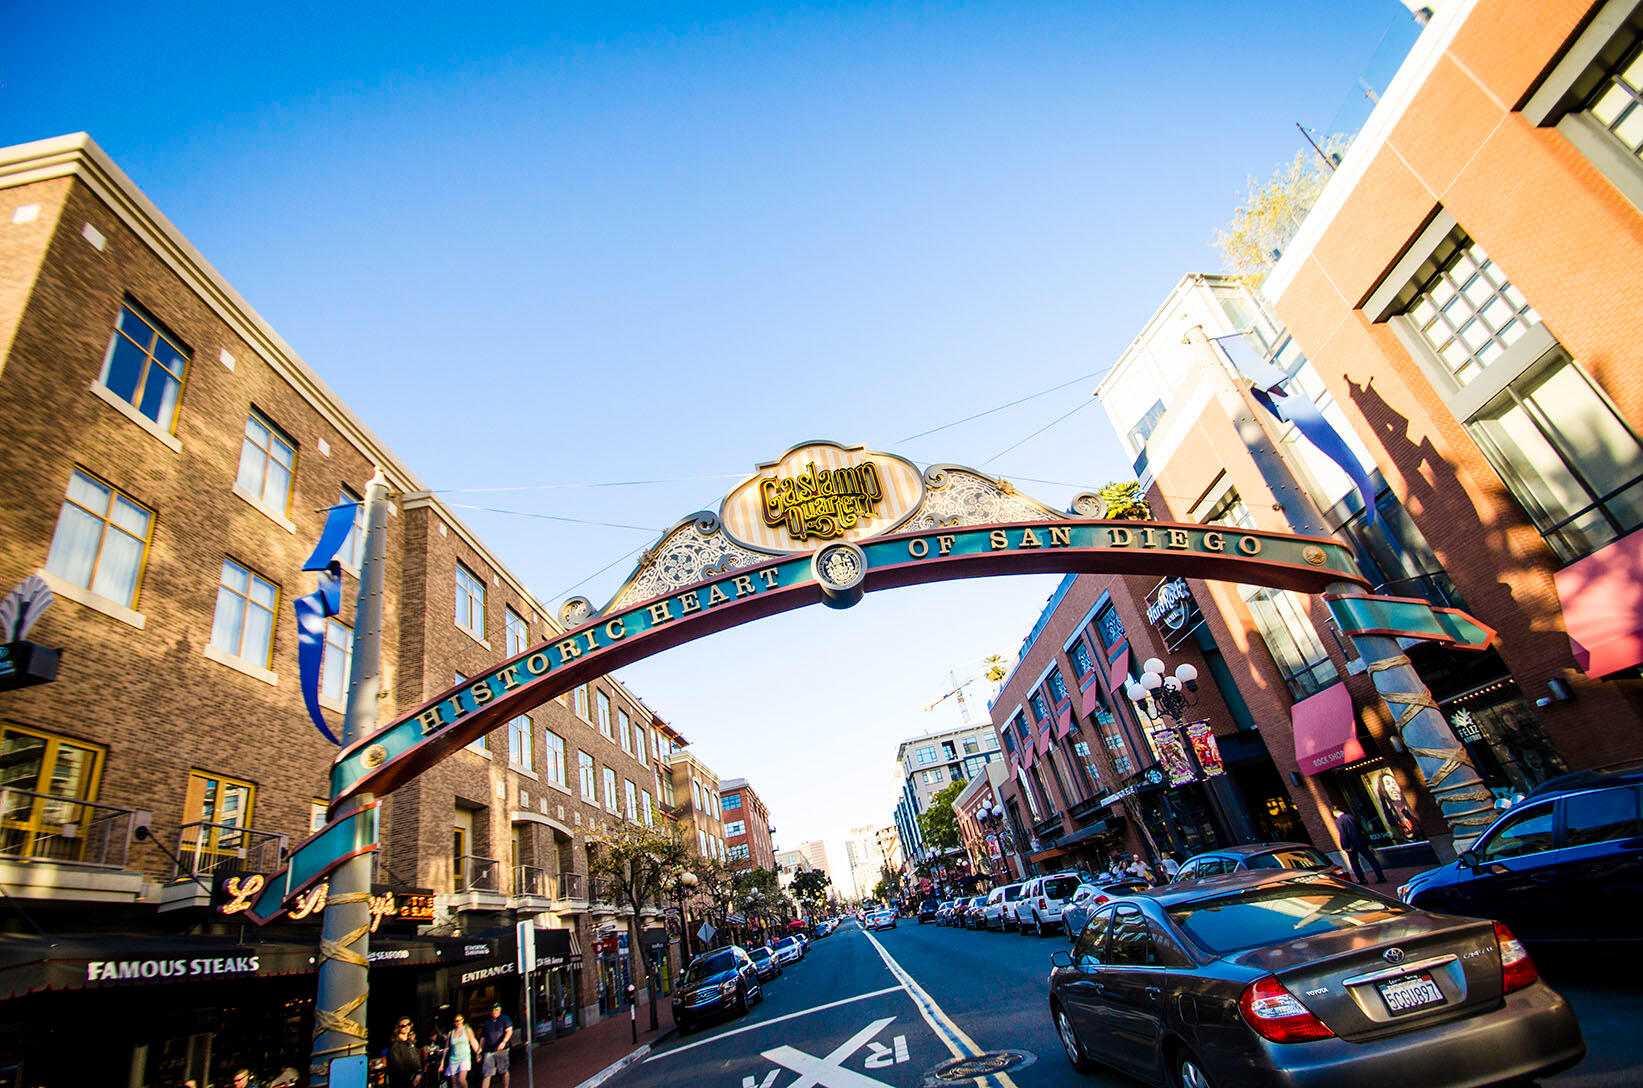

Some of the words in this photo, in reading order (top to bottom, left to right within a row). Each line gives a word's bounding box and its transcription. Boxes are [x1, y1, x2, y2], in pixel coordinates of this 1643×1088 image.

[758, 461, 883, 527] Gaslamp
[783, 493, 878, 541] Quarter
[414, 618, 627, 735] HISTORIC
[647, 567, 780, 625] HEART
[908, 534, 957, 557] OF
[989, 527, 1072, 550] SAN
[1109, 527, 1262, 555] DIEGO
[1458, 724, 1480, 738] FELIZ
[87, 960, 187, 981] FAMOUS
[190, 956, 260, 976] STEAKS
[461, 962, 514, 984] ENTRANCE
[1305, 987, 1329, 997] TOYOTA
[1386, 983, 1439, 1010] 5CGU897
